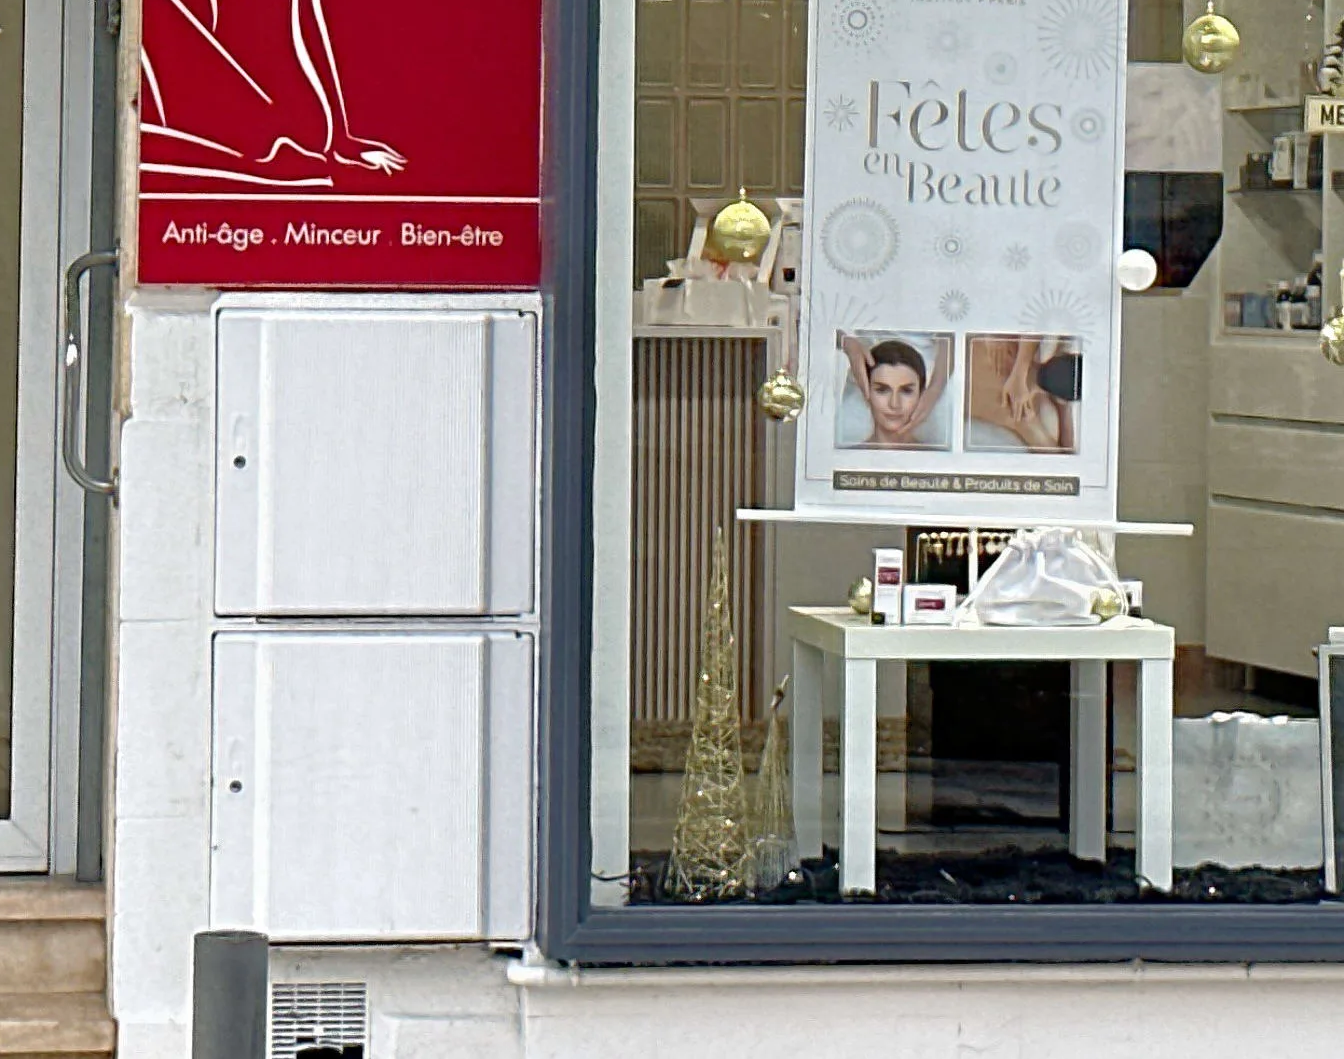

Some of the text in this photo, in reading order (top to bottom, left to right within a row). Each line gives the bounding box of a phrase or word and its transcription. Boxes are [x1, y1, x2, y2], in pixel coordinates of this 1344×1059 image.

[868, 78, 1063, 154] Fêtes
[863, 152, 905, 178] en
[162, 220, 264, 251] Anti-âge
[284, 222, 381, 245] Minceur
[401, 222, 504, 247] Bien-être
[839, 474, 876, 488] Soins
[879, 475, 899, 488] de
[901, 476, 948, 490] Beauté
[965, 477, 1020, 492] Produits
[1023, 478, 1040, 491] de
[1044, 479, 1074, 492] Soin
